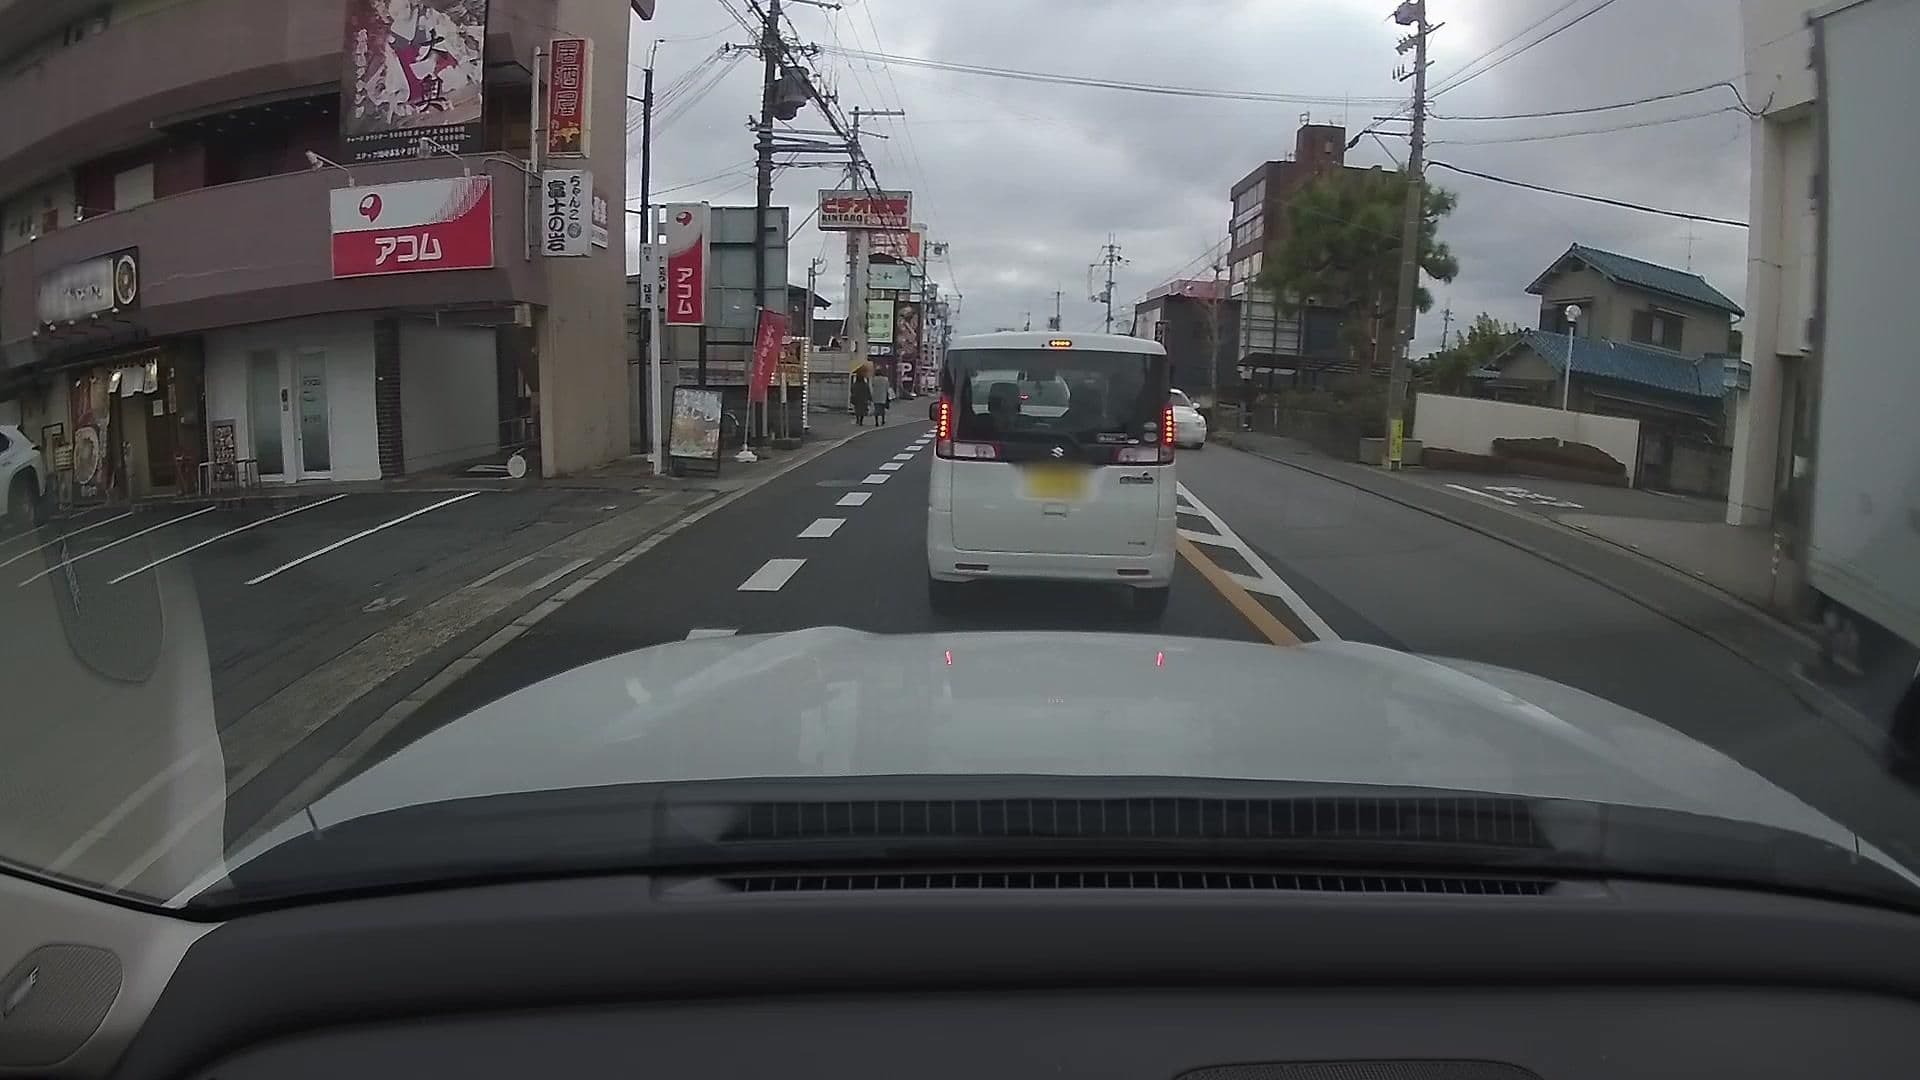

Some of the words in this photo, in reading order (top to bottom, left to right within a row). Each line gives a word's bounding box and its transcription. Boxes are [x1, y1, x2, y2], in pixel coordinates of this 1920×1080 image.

[375, 233, 442, 266] アコム
[677, 267, 693, 314] アコム
